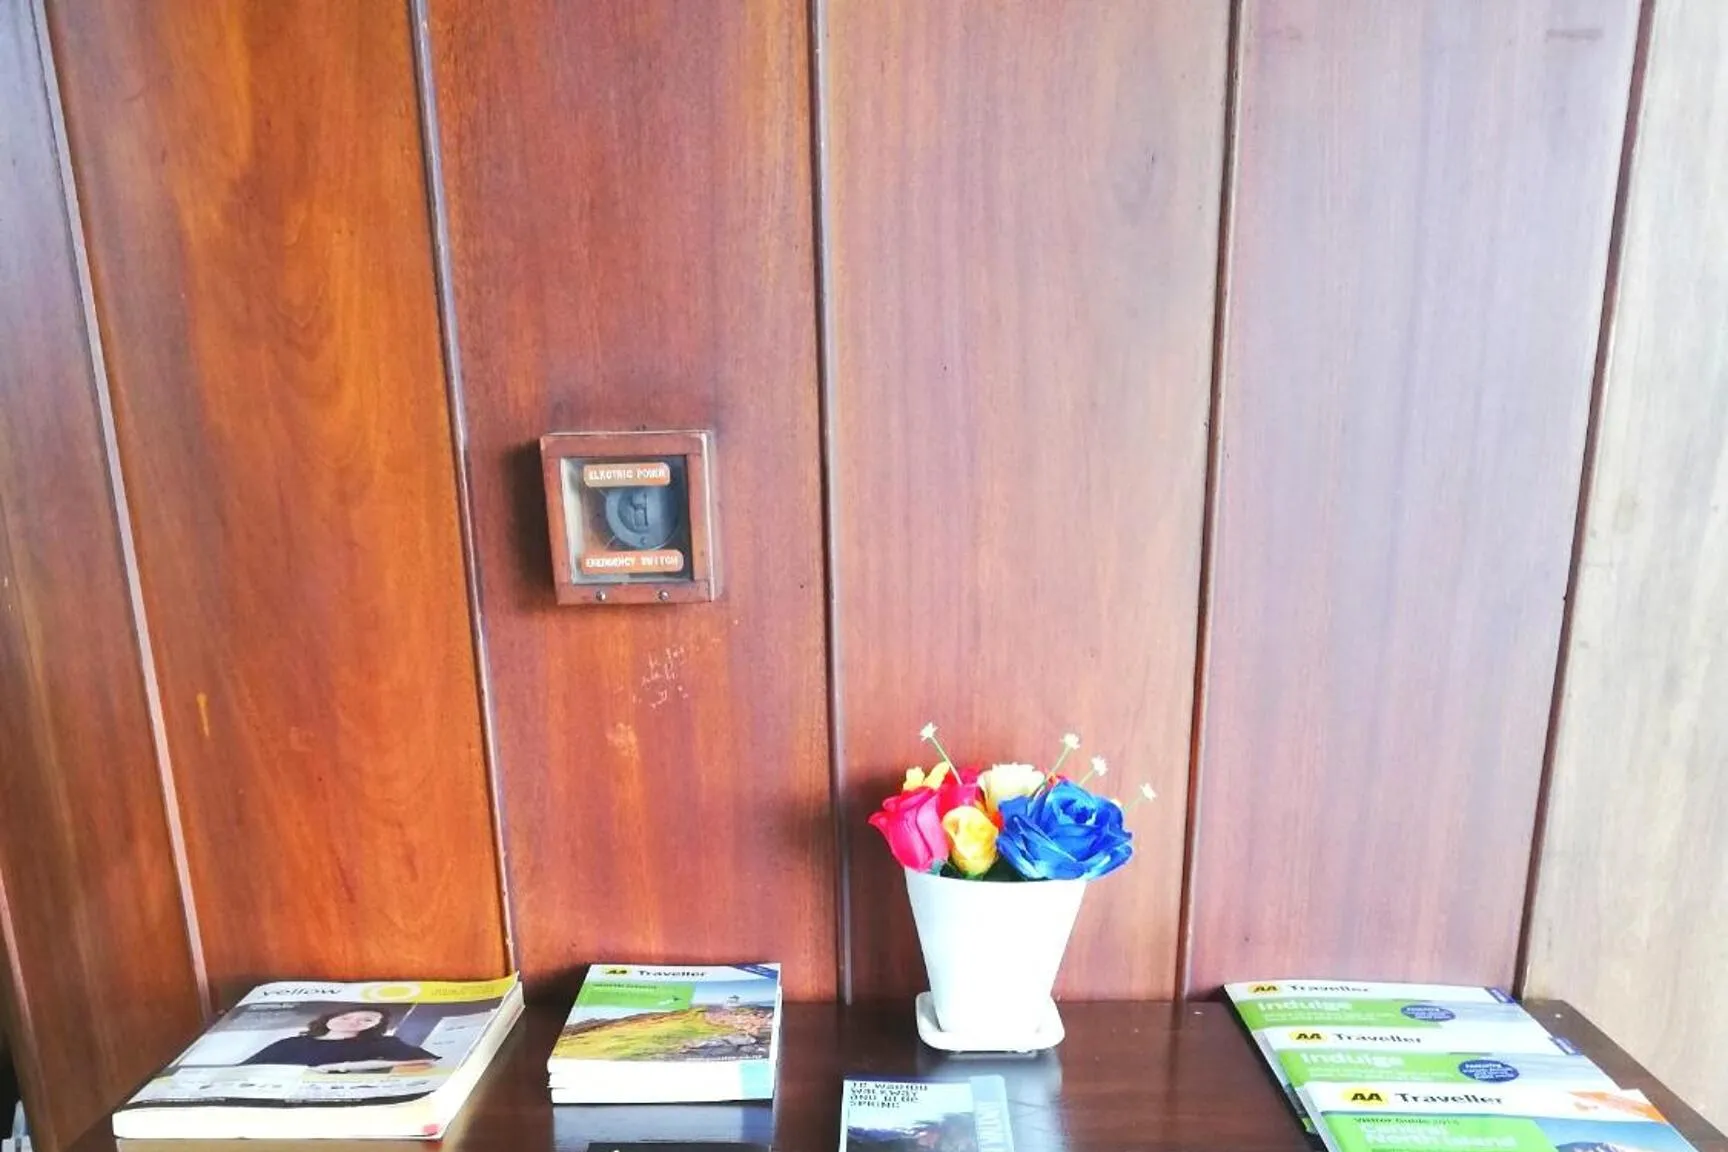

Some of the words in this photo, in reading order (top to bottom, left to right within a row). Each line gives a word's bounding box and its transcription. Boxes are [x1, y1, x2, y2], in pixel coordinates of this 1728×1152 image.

[588, 469, 633, 480] ELECTRIC
[636, 467, 666, 479] POWER
[640, 555, 678, 567] SWITCH
[638, 969, 707, 977] Traveller
[261, 985, 342, 998] yellow
[1253, 984, 1278, 992] AA
[1290, 984, 1371, 993] Traveller
[1295, 1032, 1323, 1041] AA
[1335, 1032, 1424, 1044] Traveller
[1301, 1052, 1405, 1068] Indulge
[1351, 1092, 1383, 1102] AA
[1395, 1091, 1503, 1106] Traveller
